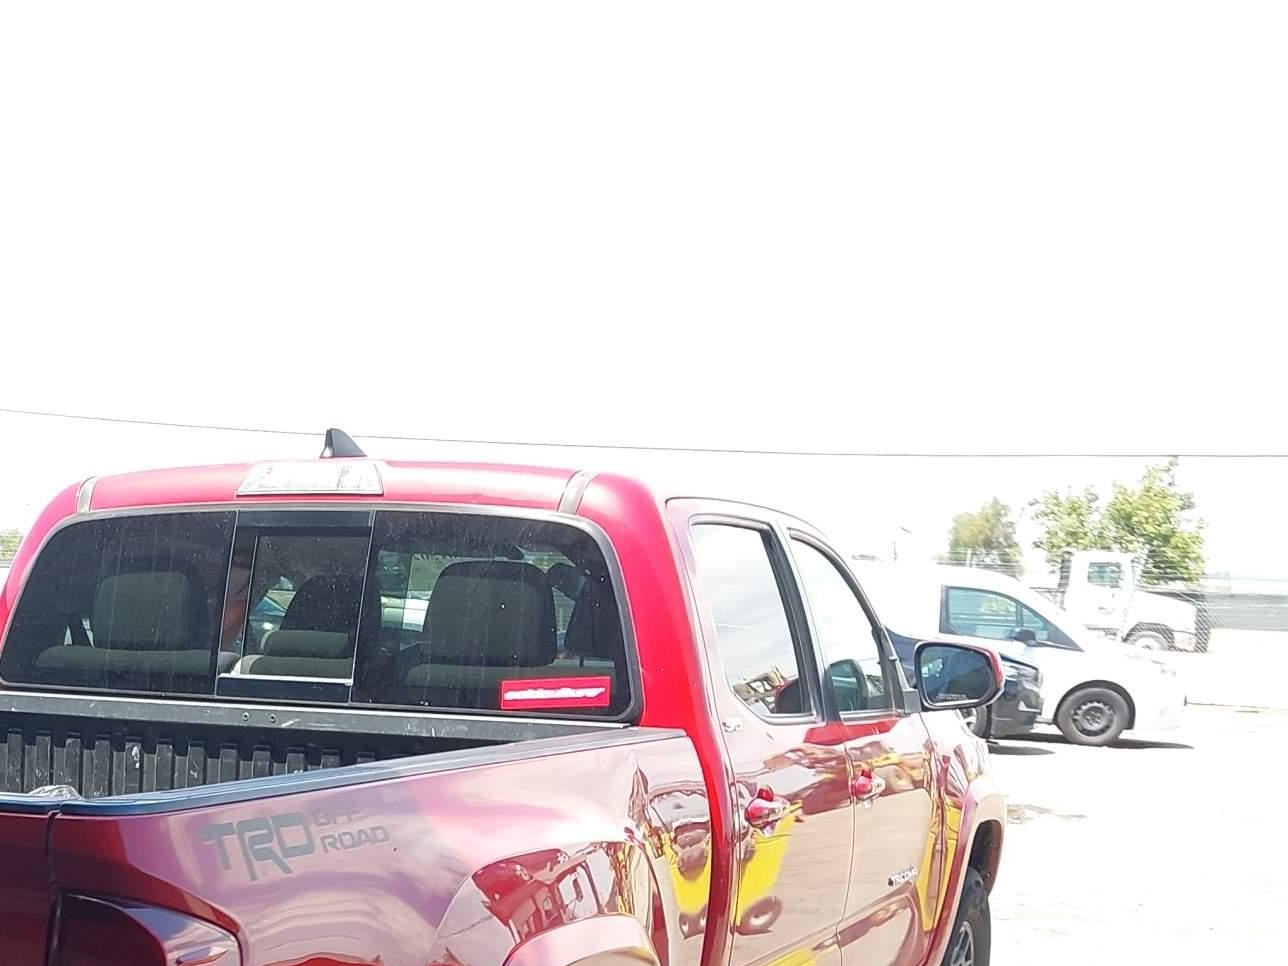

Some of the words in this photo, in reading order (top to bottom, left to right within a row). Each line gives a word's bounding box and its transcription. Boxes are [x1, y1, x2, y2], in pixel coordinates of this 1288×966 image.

[200, 812, 315, 882] TRD
[313, 807, 361, 828] OFF
[320, 825, 392, 854] ROAD
